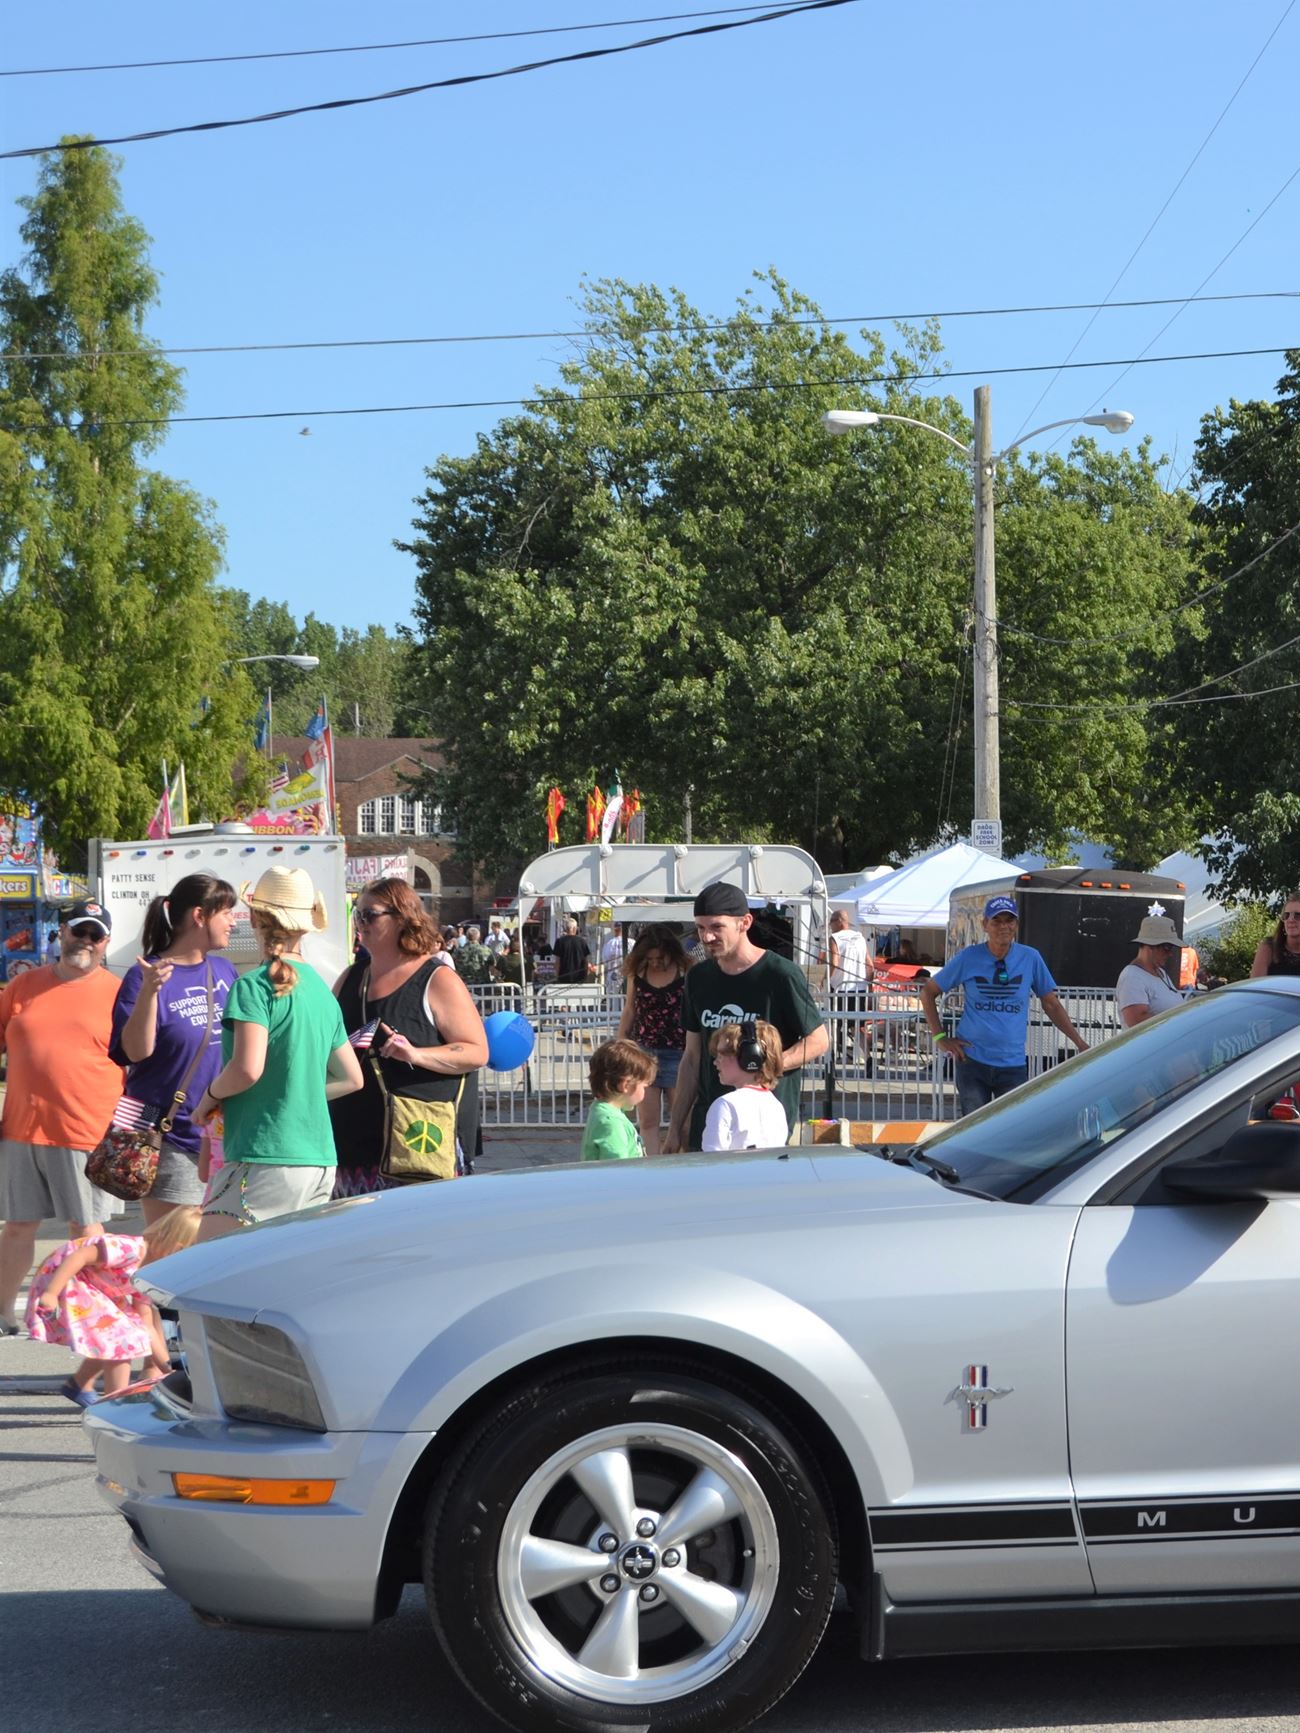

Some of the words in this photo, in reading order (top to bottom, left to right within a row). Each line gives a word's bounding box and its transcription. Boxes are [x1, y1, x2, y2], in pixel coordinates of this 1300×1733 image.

[254, 825, 295, 835] IBBON
[112, 874, 131, 882] PATTY
[135, 873, 155, 881] SENSE
[111, 891, 137, 899] CLINTON
[169, 995, 207, 1012] SUPPORT
[975, 1001, 1021, 1014] adidas
